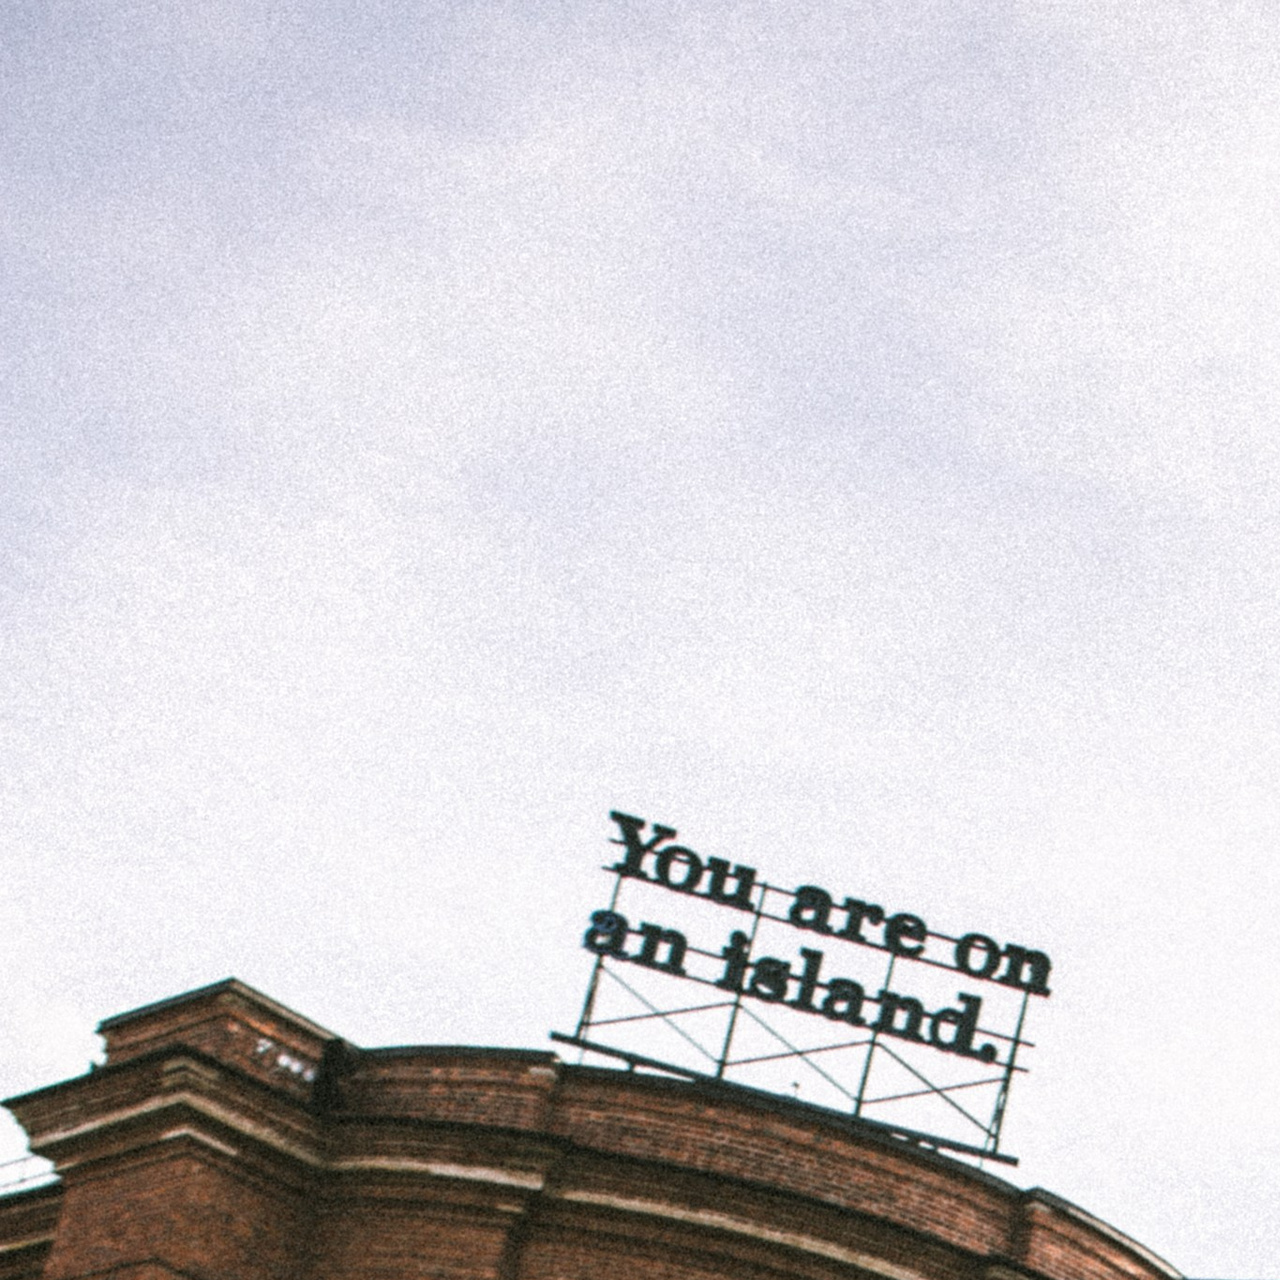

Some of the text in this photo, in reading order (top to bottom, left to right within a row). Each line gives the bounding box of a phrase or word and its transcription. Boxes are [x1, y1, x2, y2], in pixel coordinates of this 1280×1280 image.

[582, 909, 998, 1065] an island.
[610, 809, 1052, 998] You are on
